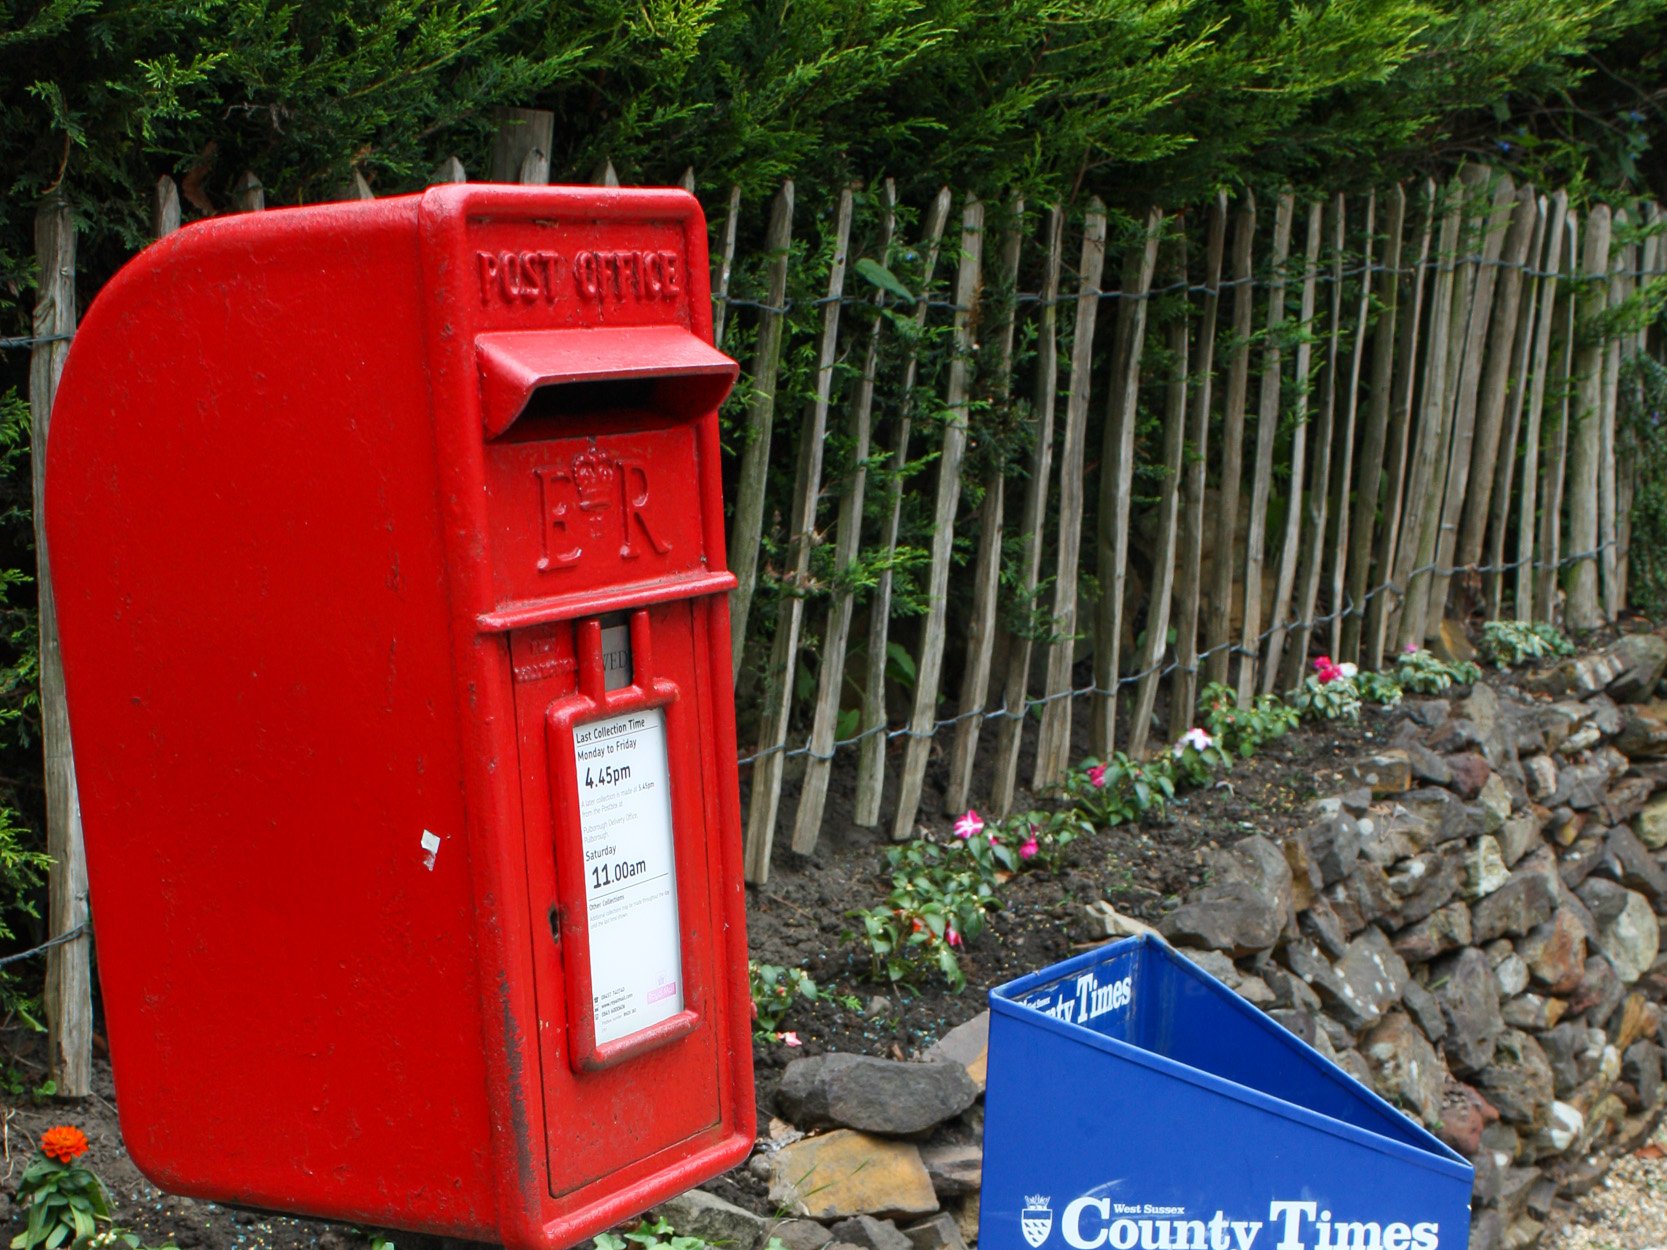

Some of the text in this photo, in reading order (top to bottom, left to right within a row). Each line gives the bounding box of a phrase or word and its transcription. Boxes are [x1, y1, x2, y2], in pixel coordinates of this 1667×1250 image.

[476, 250, 680, 306] POST OFFICE
[576, 718, 645, 744] Last Collection Time
[577, 739, 637, 762] Monday to Friday
[585, 765, 631, 789] 4.45pm
[585, 843, 617, 862] Saturday
[591, 858, 647, 889] 11.00am
[1076, 973, 1132, 1024] Times
[1113, 1203, 1185, 1215] West Sussex
